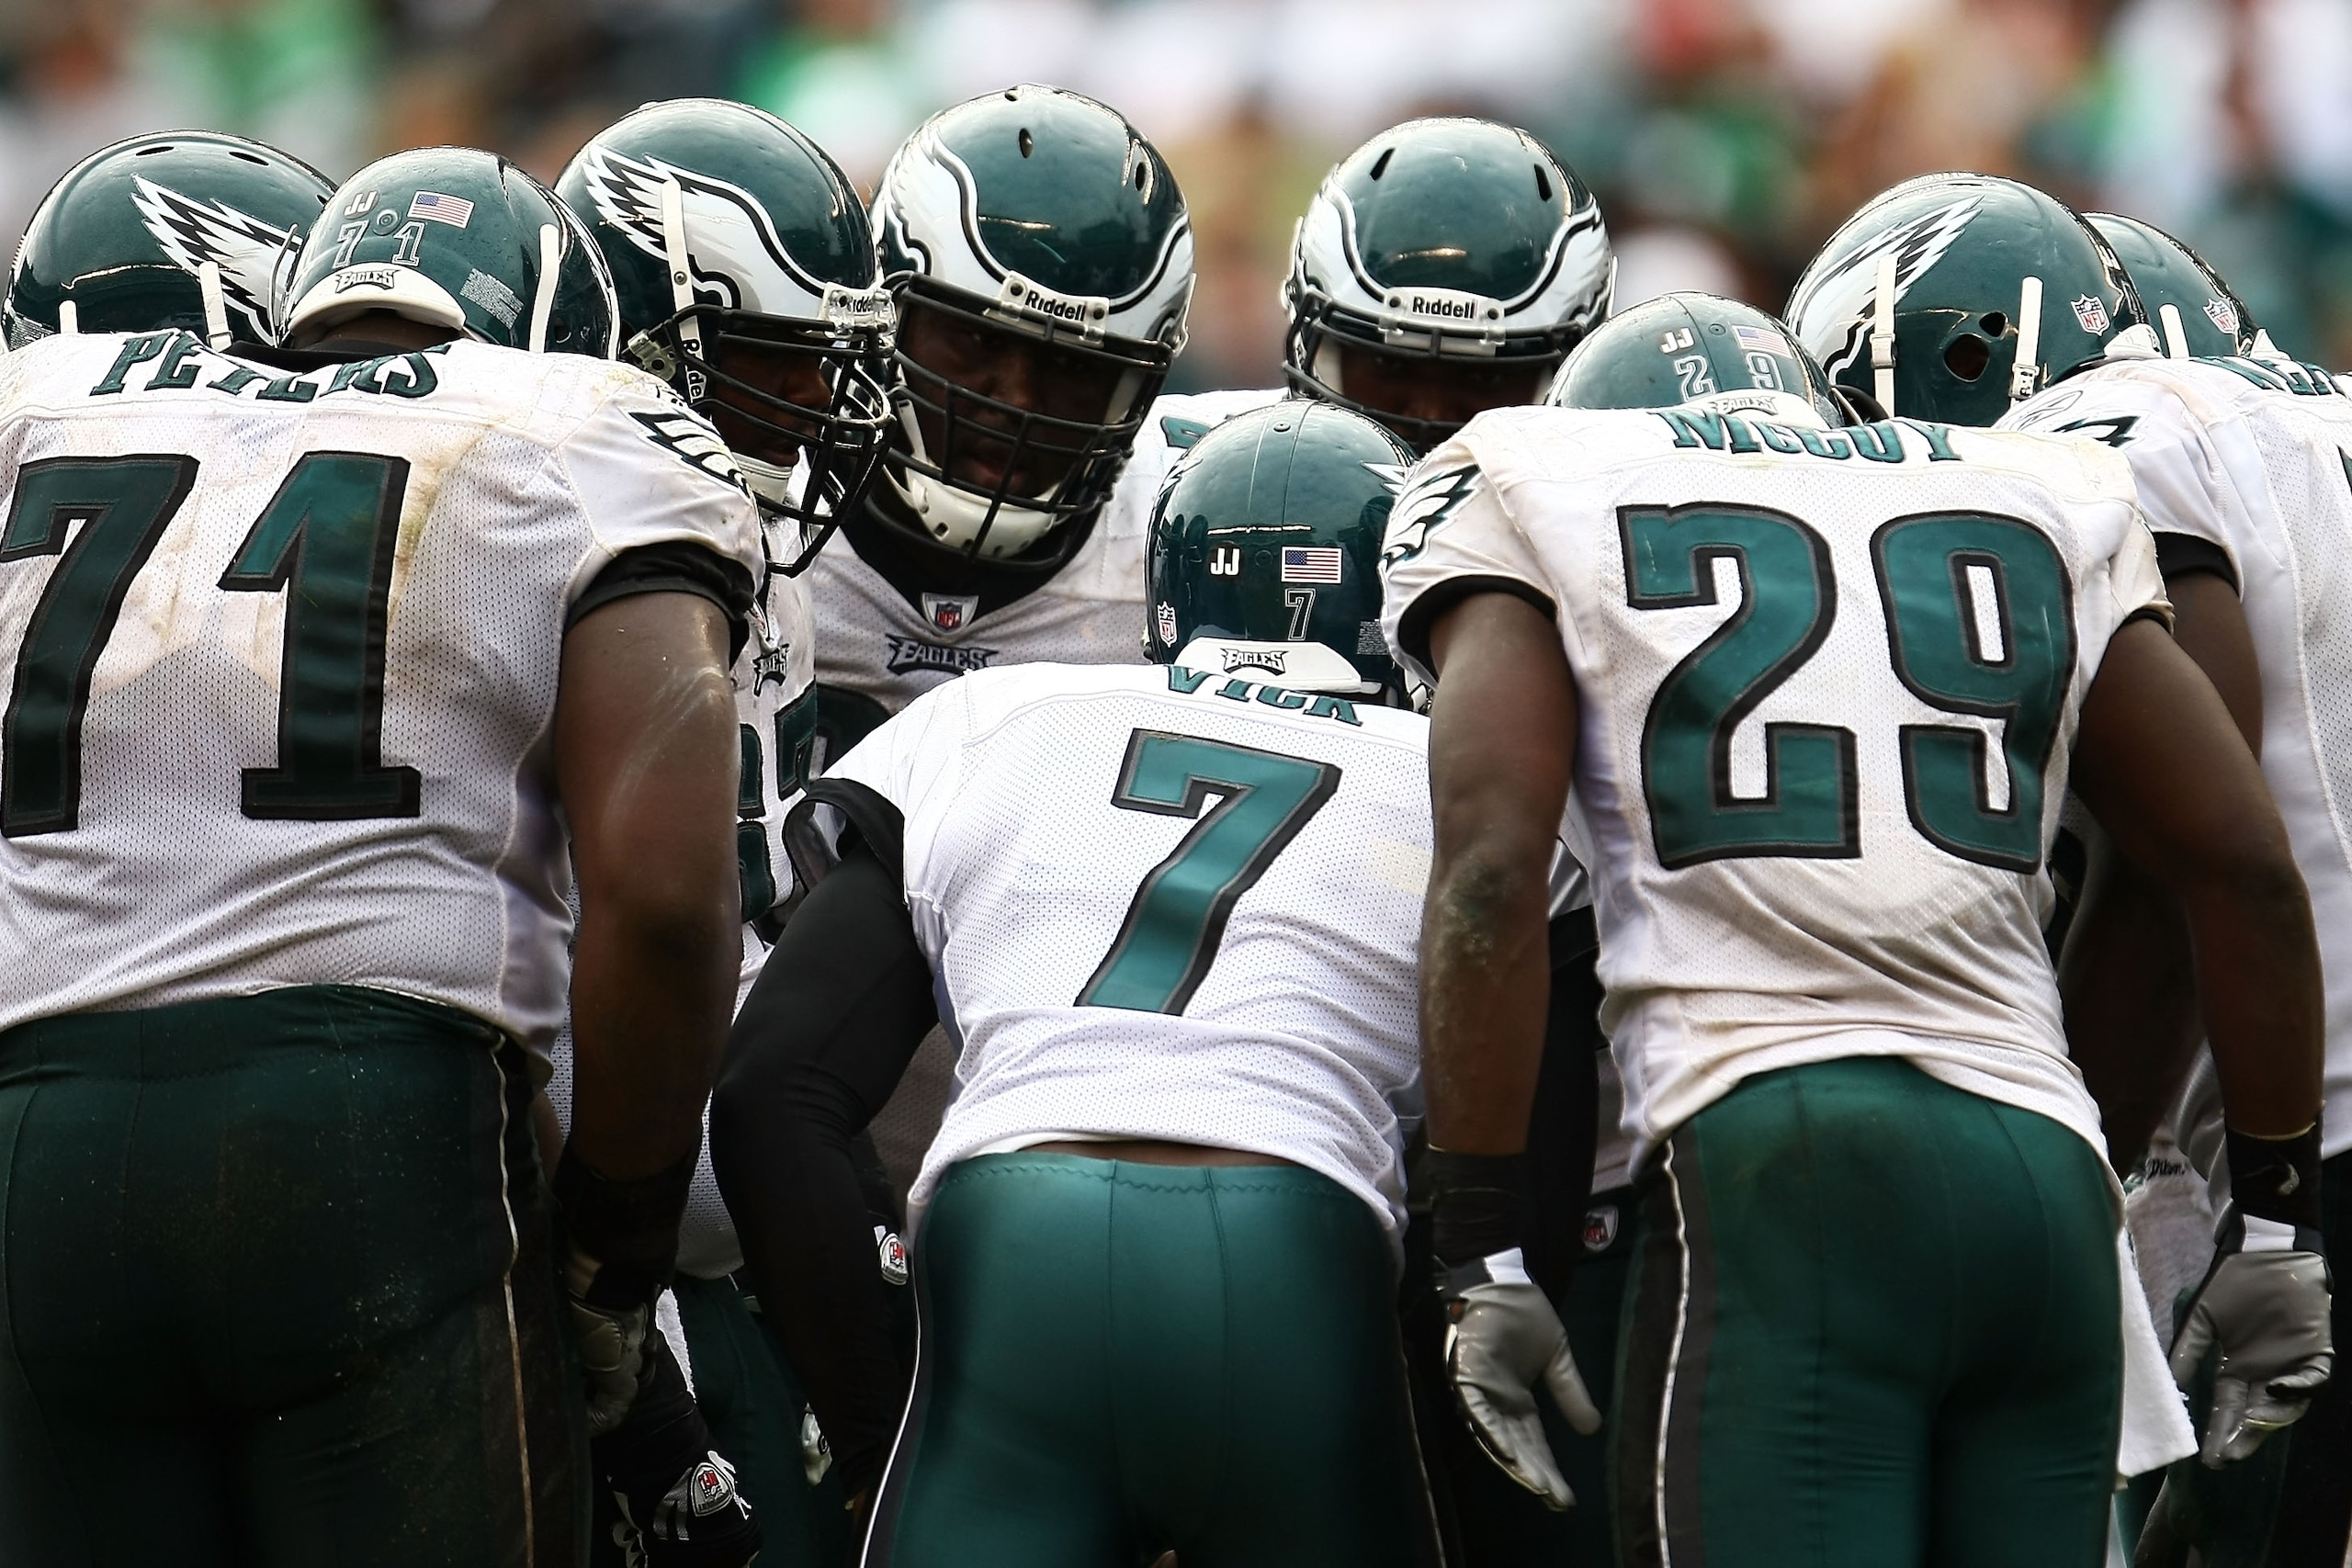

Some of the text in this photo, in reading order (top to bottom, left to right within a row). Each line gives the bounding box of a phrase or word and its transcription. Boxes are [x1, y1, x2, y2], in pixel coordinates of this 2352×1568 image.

[344, 191, 378, 216] JJ
[333, 220, 425, 269] 71
[335, 269, 401, 293] EAGLES
[1024, 289, 1086, 321] Riddell
[1412, 296, 1475, 319] Riddell
[2082, 310, 2106, 329] NFL
[2215, 313, 2236, 329] NFL
[1660, 327, 1695, 354] JJ
[1674, 351, 1785, 402] 29
[1707, 395, 1778, 415] EAGLES
[1210, 547, 1240, 575] JJ
[937, 611, 960, 627] NFL
[1284, 588, 1317, 640] 7
[0, 450, 422, 838] 71
[1160, 621, 1176, 639] NFL
[885, 634, 999, 675] EAGLES
[1220, 648, 1289, 676] EAGLES
[1617, 501, 2078, 874] 29
[1074, 728, 1343, 1016] 7
